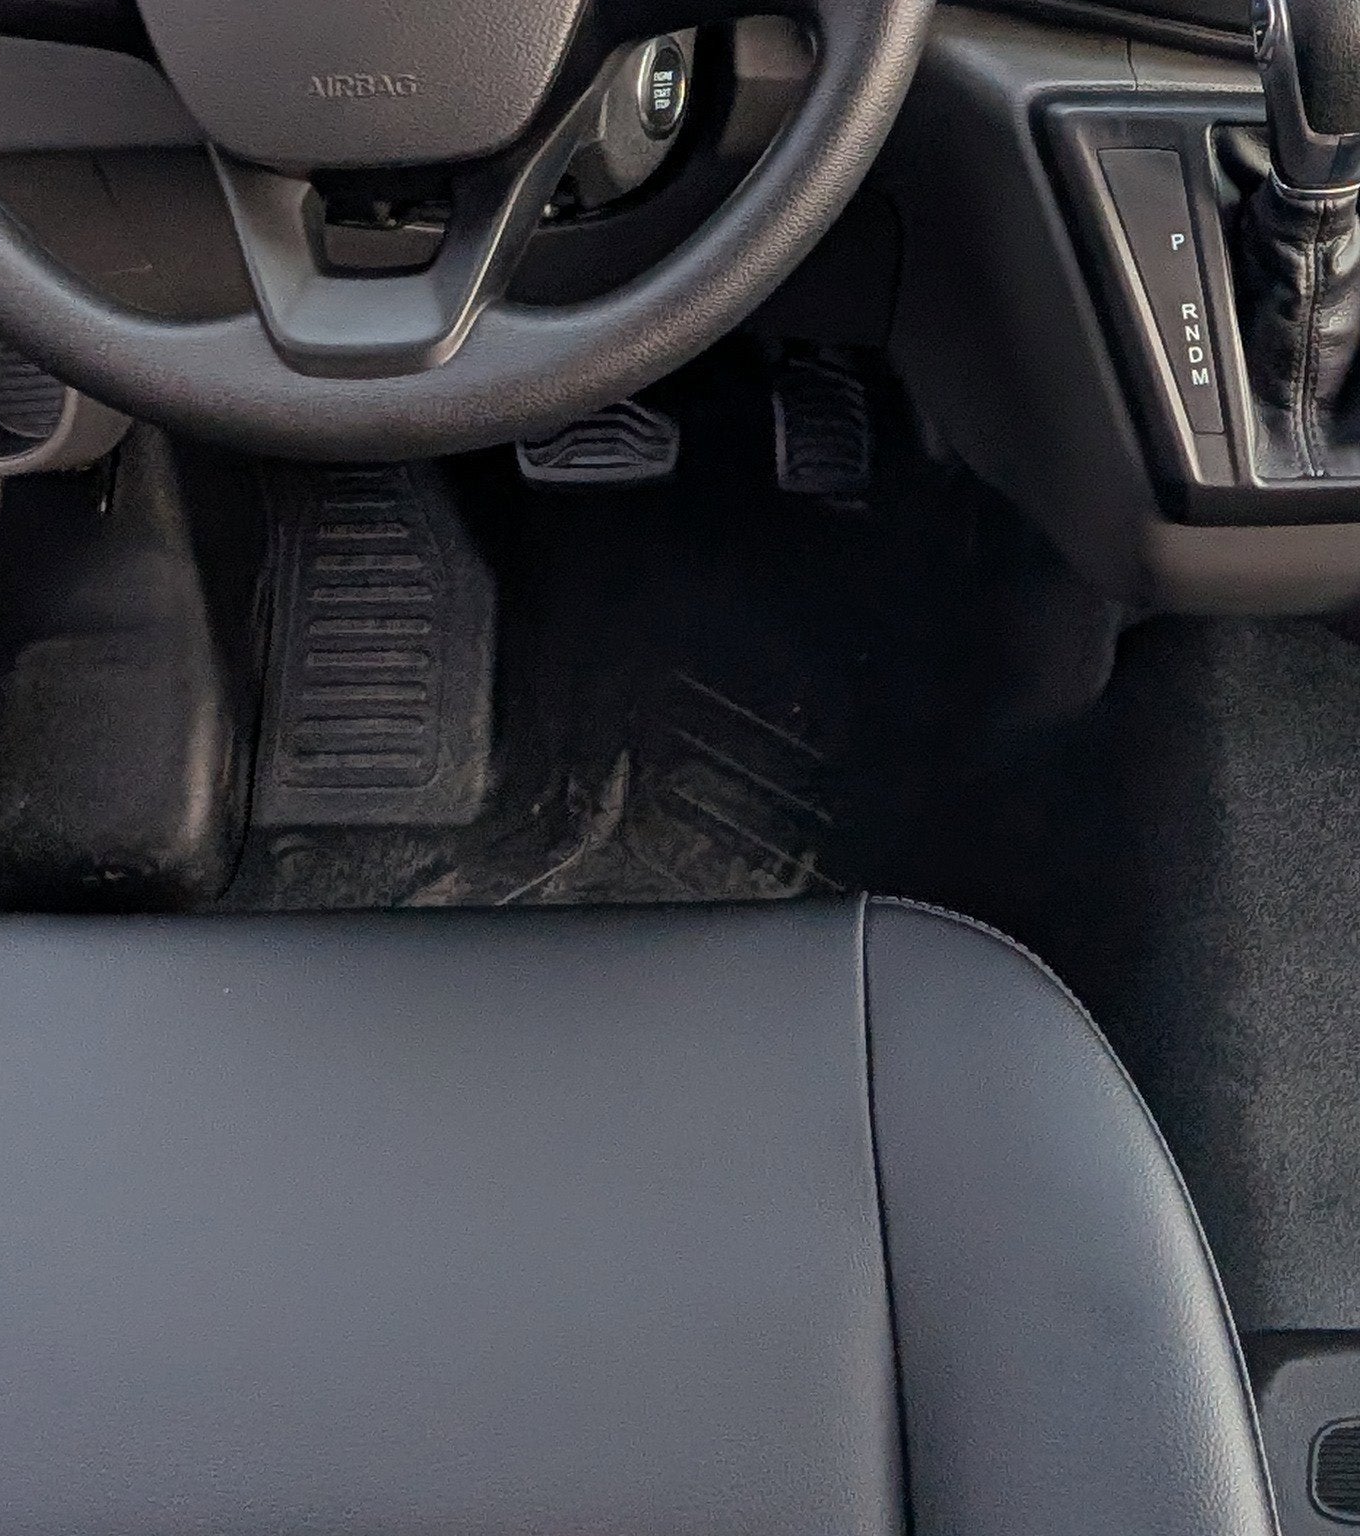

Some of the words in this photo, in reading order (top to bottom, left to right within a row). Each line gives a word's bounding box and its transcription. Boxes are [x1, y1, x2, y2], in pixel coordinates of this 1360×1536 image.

[309, 73, 422, 97] AIRBAG
[1170, 232, 1185, 251] P
[1181, 302, 1199, 320] R
[1185, 324, 1200, 342] N
[1189, 346, 1204, 364] D
[1191, 367, 1210, 386] M
